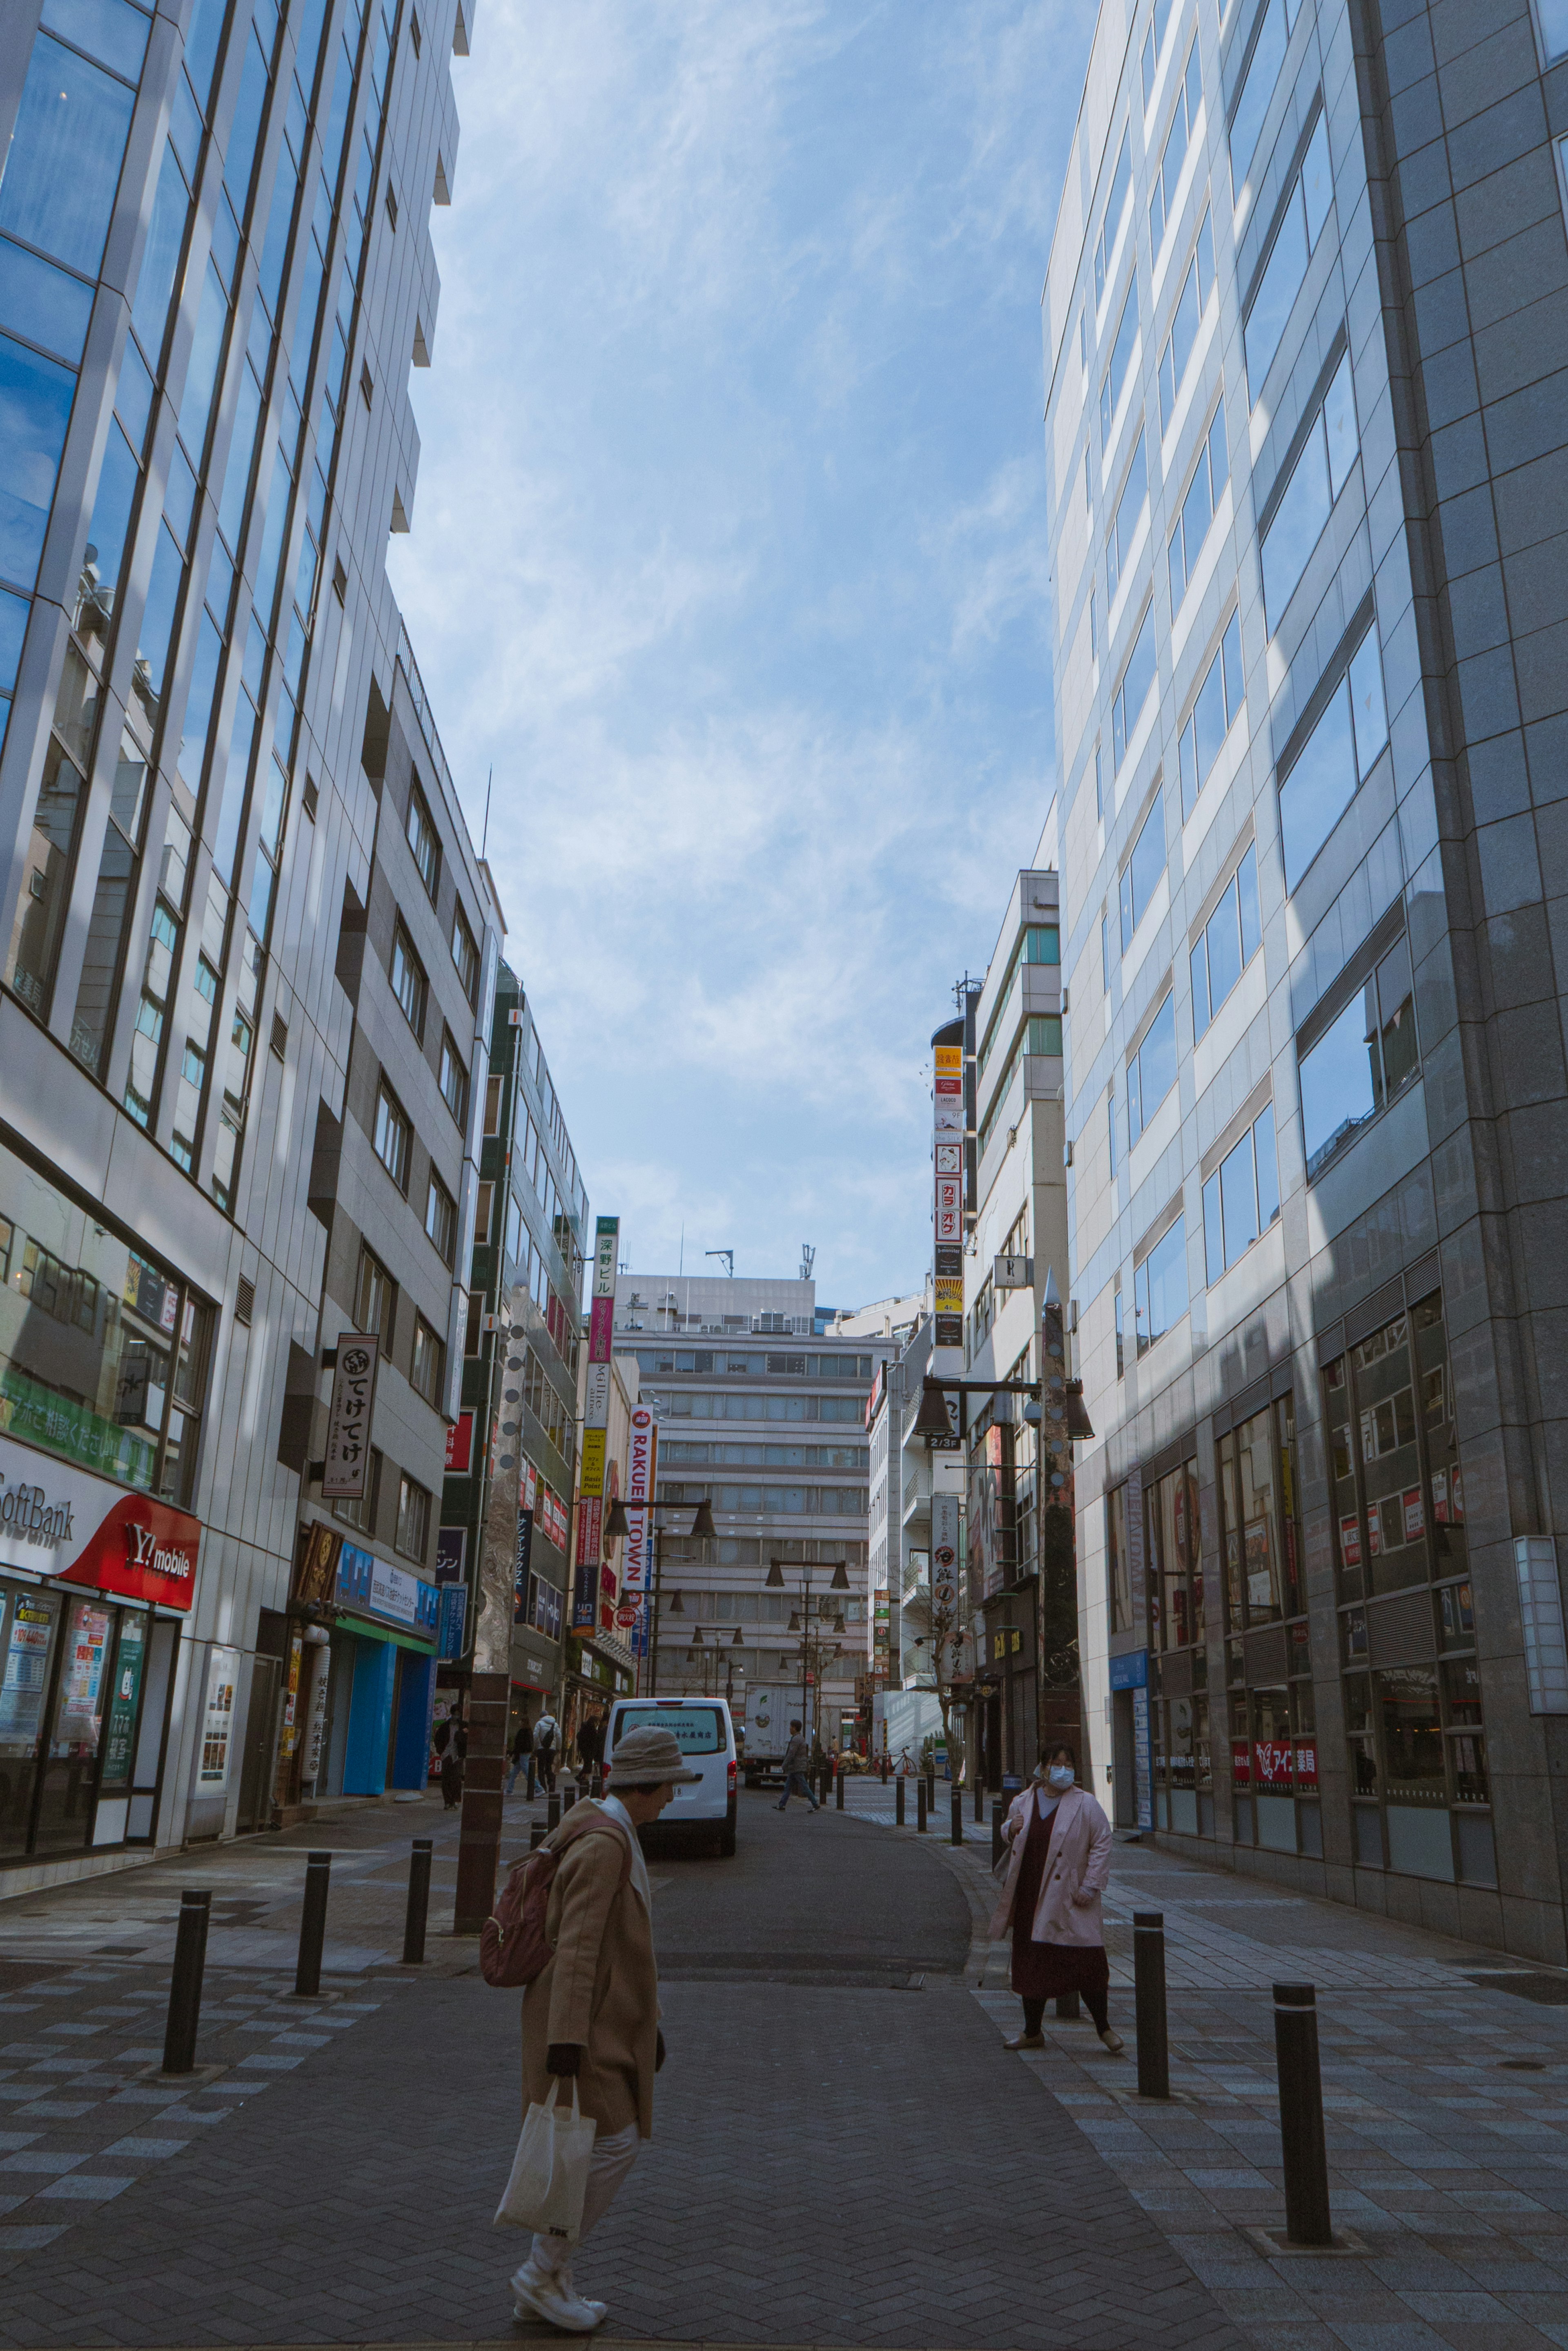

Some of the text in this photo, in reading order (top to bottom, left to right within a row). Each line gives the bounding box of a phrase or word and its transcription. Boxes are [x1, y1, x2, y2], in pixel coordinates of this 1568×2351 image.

[937, 1054, 960, 1064] 鳥貴族
[942, 1185, 956, 1234] カラオケ
[598, 1239, 612, 1293] 深野ビル
[596, 1365, 606, 1411] Millie
[342, 1378, 368, 1463] てけてけ
[931, 1438, 957, 1448] 2/3F
[631, 1435, 647, 1511] RAKUEN
[0, 1472, 75, 1541] oftBank
[627, 1516, 644, 1581] TOWN
[447, 1592, 458, 1657] 池袋チケットセンター
[618, 1613, 635, 1622] 消火栓
[112, 1714, 130, 1734] スマホ
[109, 1738, 127, 1760] 教室
